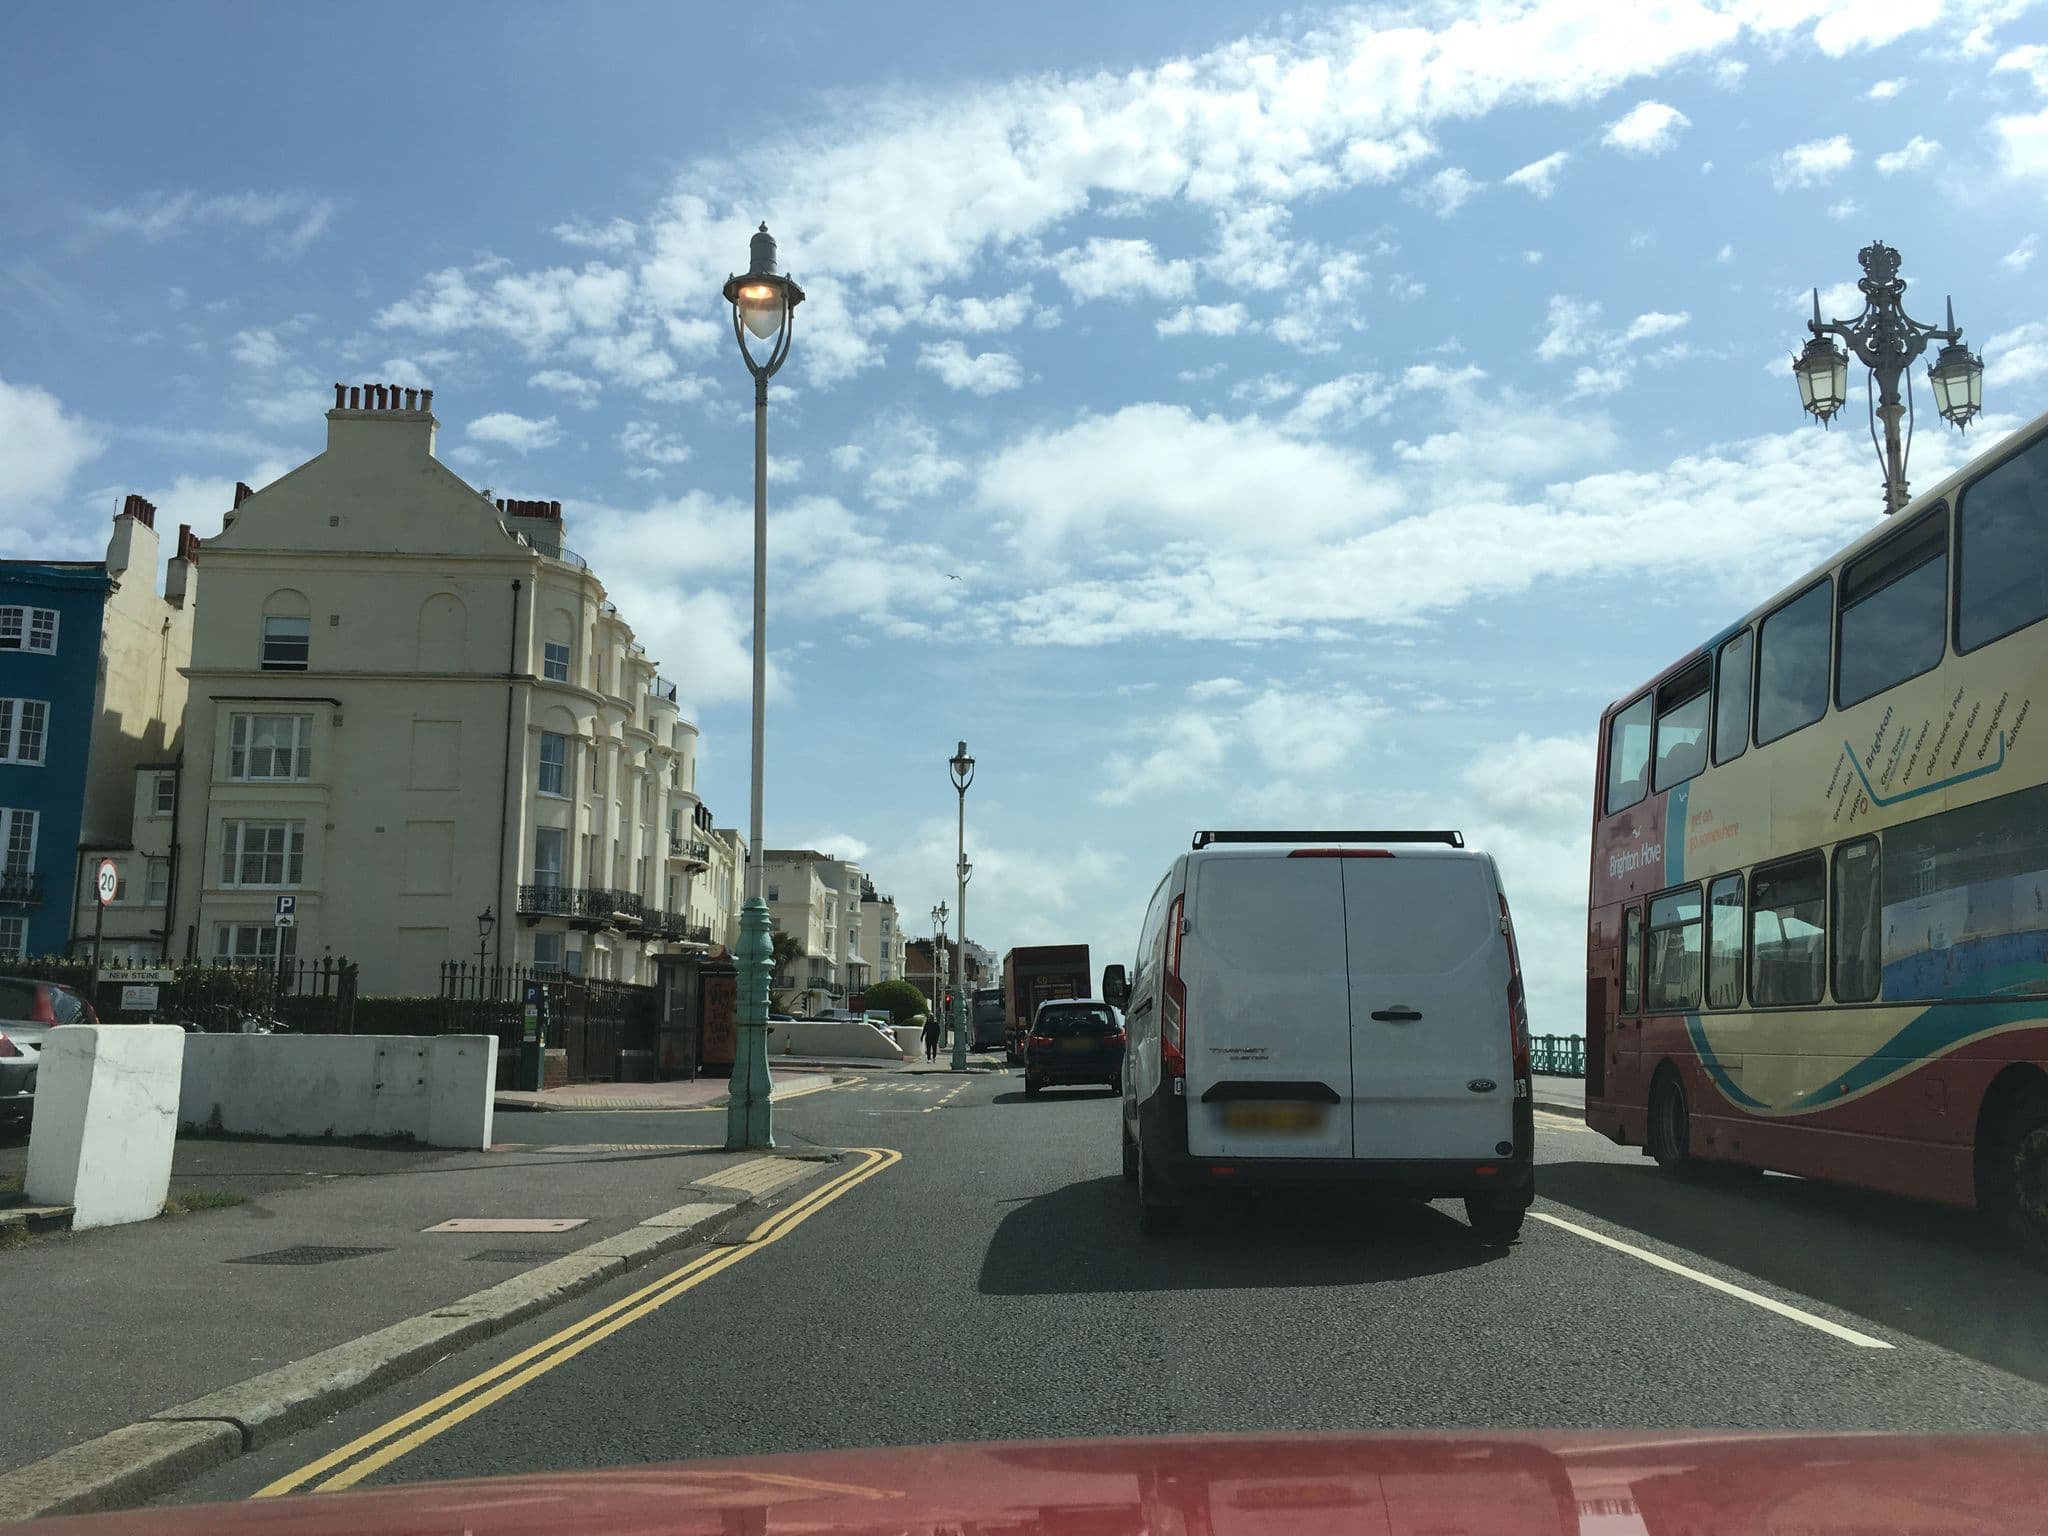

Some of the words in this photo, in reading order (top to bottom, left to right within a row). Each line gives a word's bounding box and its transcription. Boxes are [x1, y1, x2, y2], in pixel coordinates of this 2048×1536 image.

[1865, 706, 1894, 771] Brighton
[1926, 753, 1937, 777] Old
[1952, 686, 1965, 710] Pier
[1977, 691, 2009, 761] Rottingdean
[2006, 699, 2031, 752] Saltdean
[1951, 729, 1969, 770] Marine
[1880, 758, 1894, 786] Clock
[1902, 753, 1918, 785] North
[1609, 849, 1640, 880] Brighton
[1641, 841, 1662, 866] Hove
[101, 873, 115, 892] 20
[280, 897, 293, 913] P
[109, 972, 129, 980] NEW
[132, 972, 160, 980] STEINE
[528, 988, 536, 1000] P
